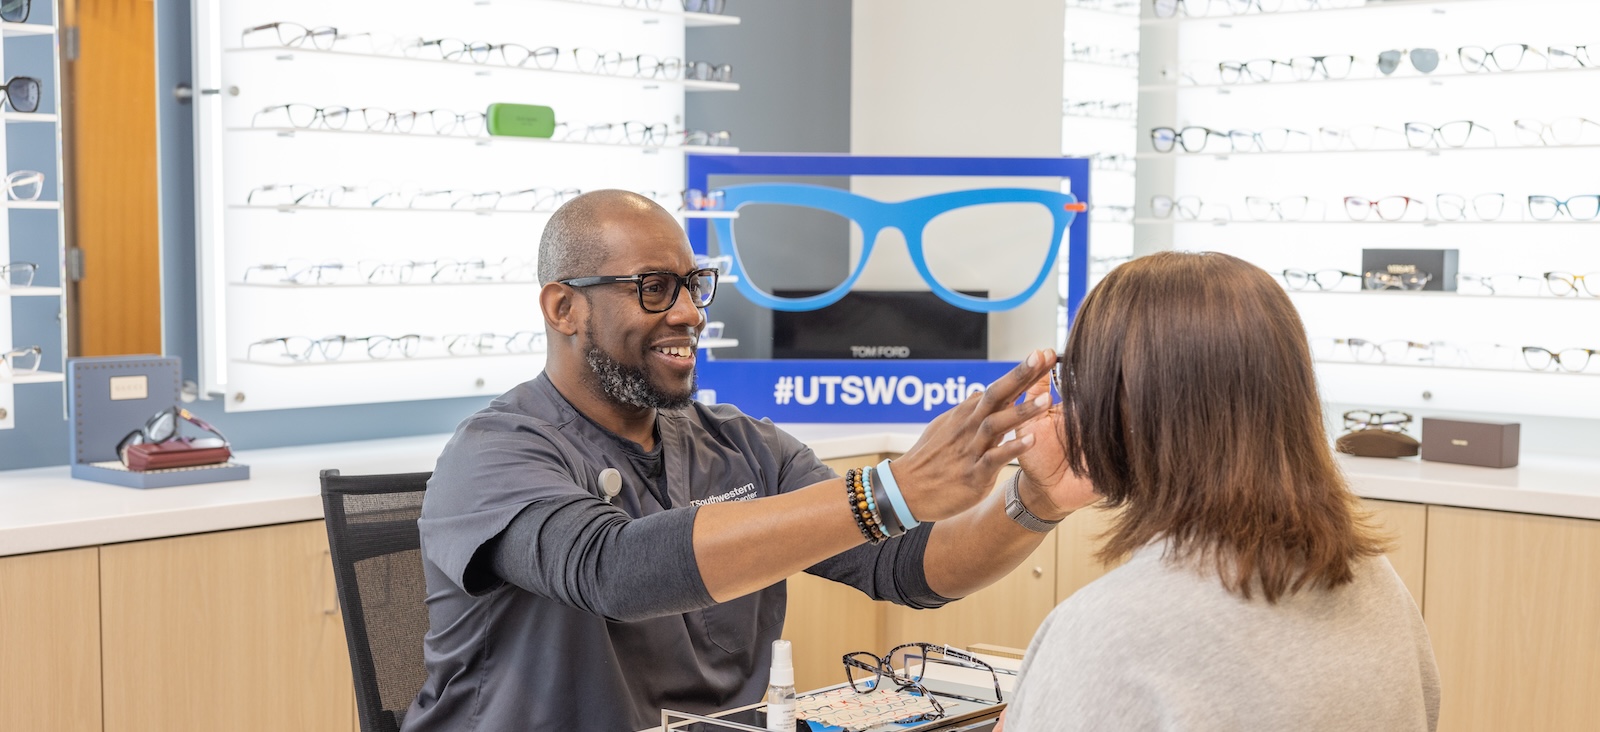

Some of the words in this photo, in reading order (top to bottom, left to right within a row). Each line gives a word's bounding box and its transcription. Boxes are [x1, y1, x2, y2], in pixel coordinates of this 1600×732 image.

[851, 346, 877, 358] TOM
[878, 346, 910, 358] FORD
[774, 376, 993, 411] #UTSWOptic
